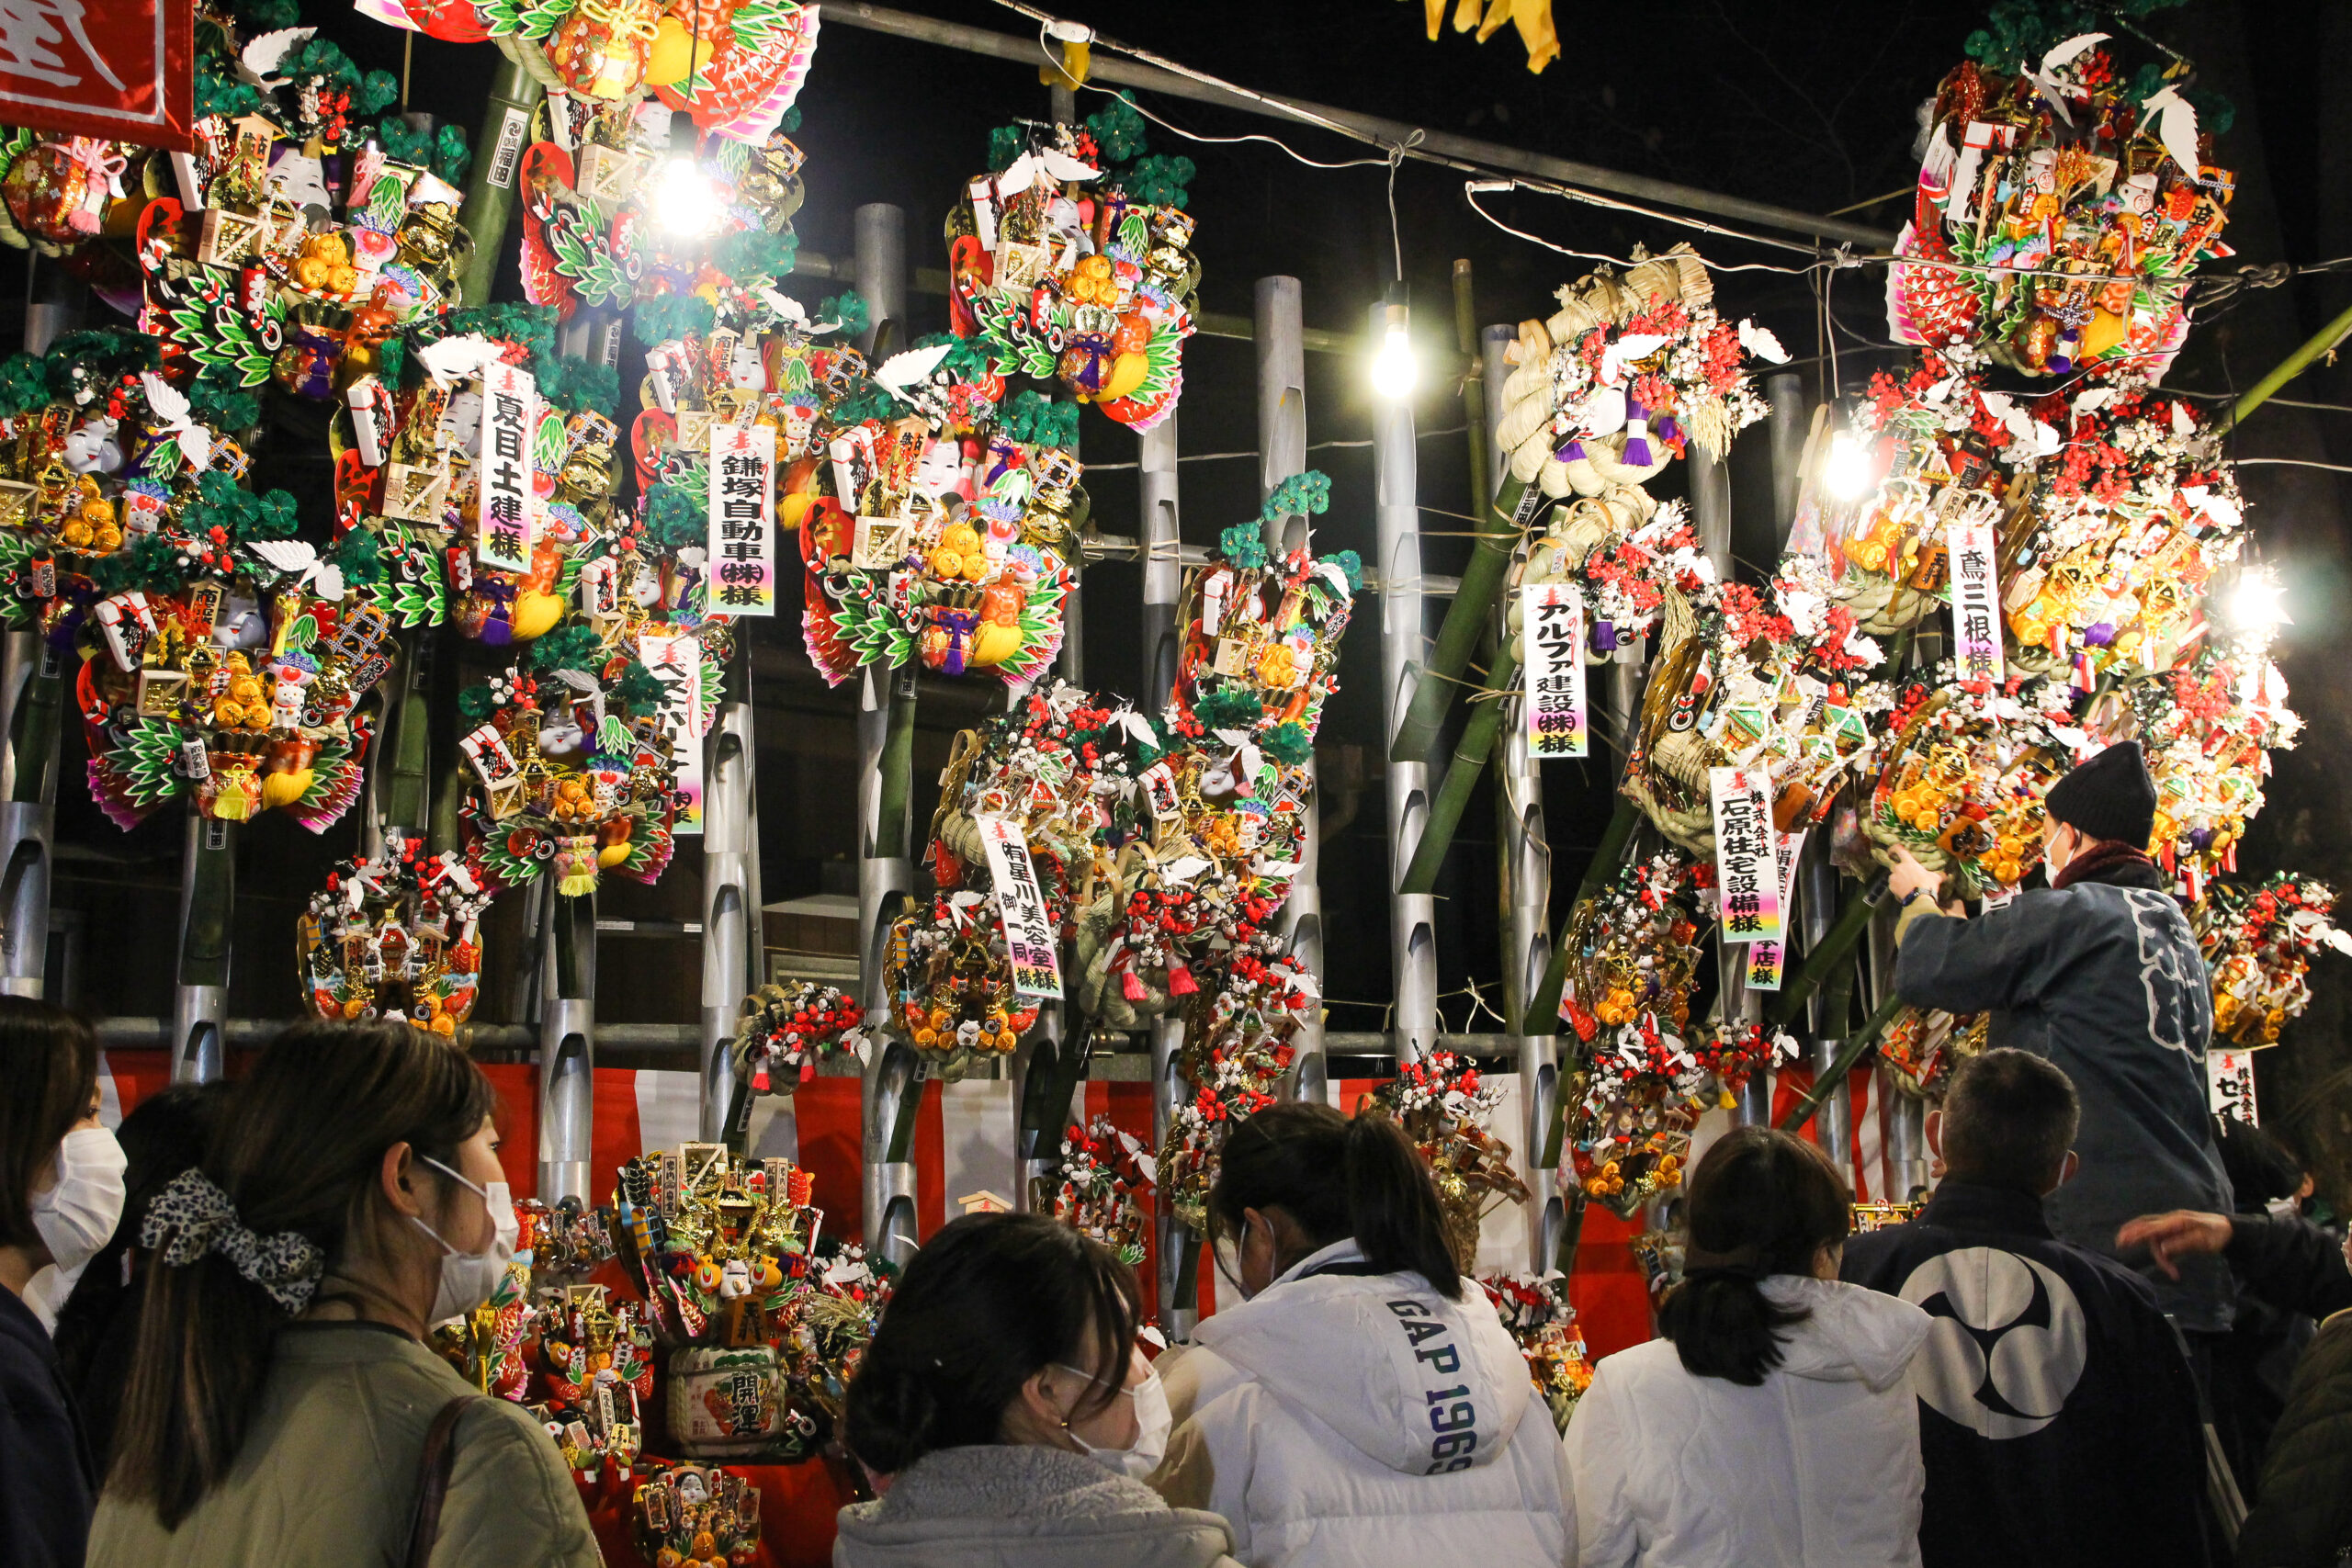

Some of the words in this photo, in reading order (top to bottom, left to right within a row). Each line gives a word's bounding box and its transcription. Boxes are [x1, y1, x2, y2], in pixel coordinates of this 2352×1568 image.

[490, 392, 524, 563] 夏目土建様
[1960, 549, 1994, 676] 鳶三根様
[1721, 797, 1763, 934] 石原住宅設備様
[1750, 791, 1770, 858] 株式会社
[1001, 892, 1034, 987] 御一同様
[1386, 1300, 1461, 1374] GAP
[731, 1374, 763, 1437] 開運
